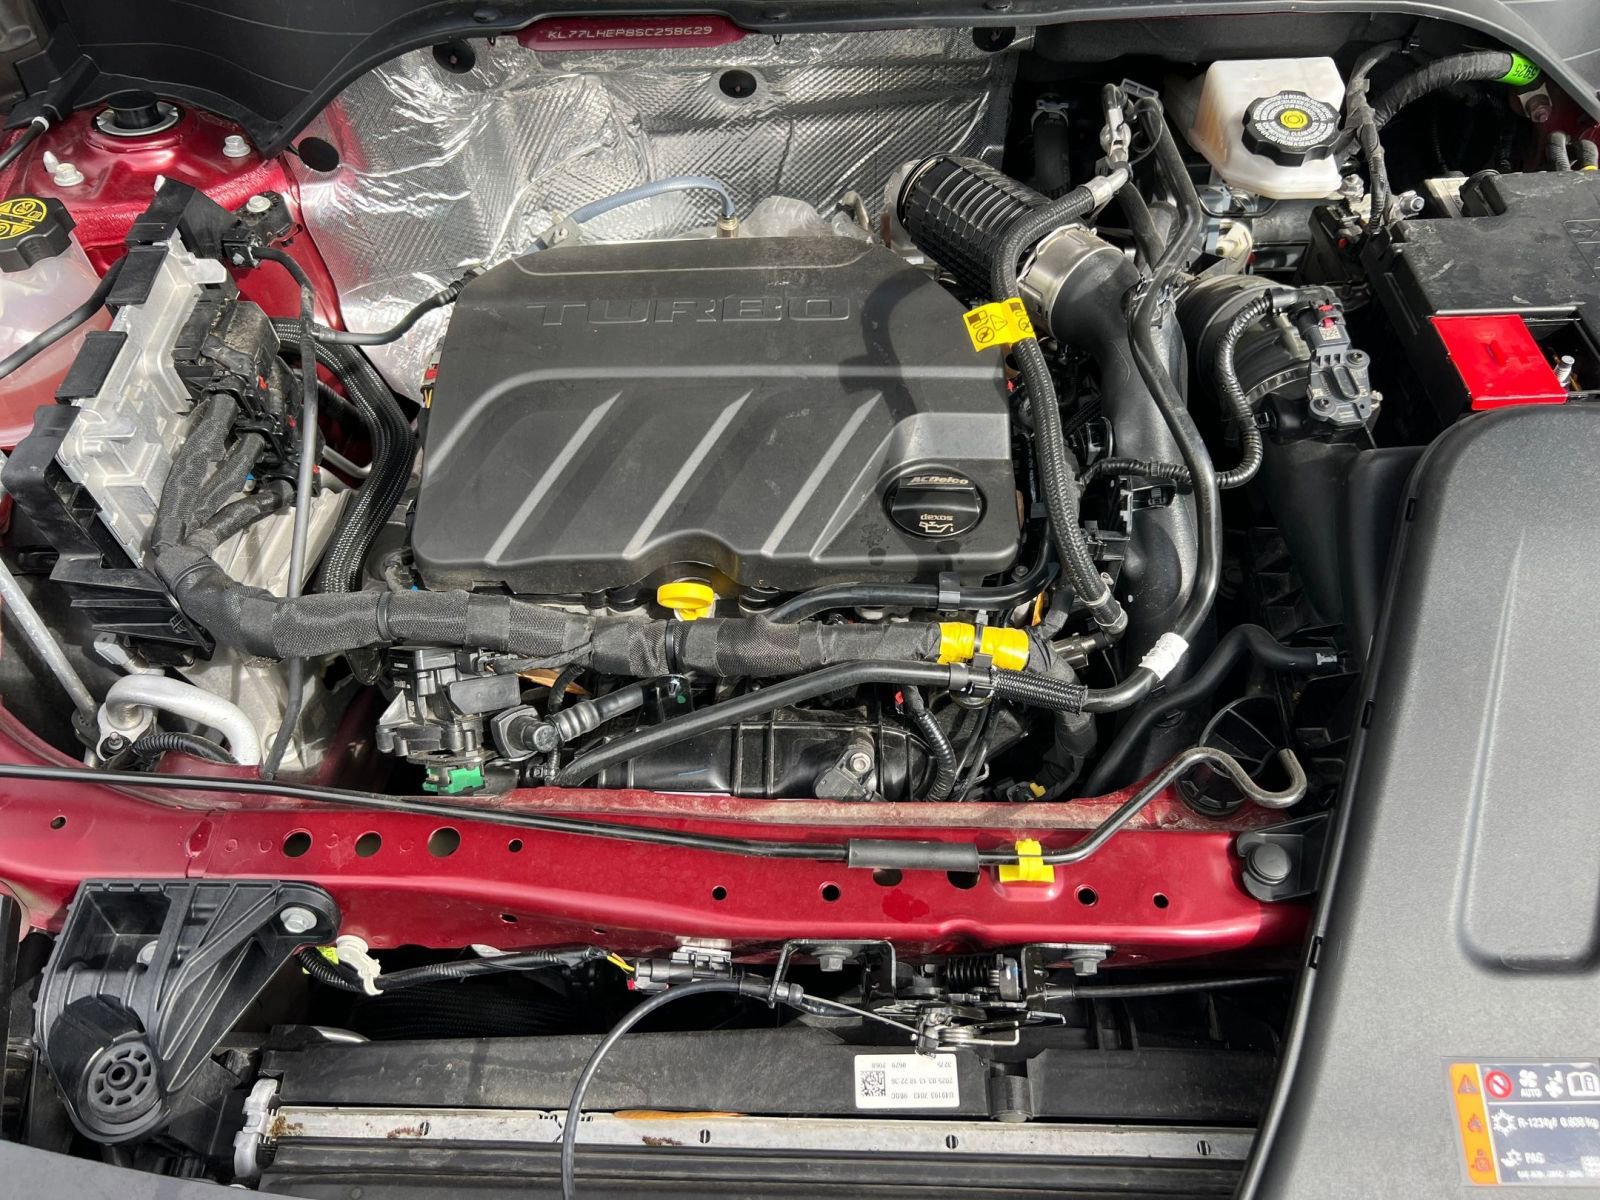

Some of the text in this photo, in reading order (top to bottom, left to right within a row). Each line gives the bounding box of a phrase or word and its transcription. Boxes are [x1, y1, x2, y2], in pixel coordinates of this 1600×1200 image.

[547, 26, 713, 40] KL77LHEP8SC258629
[526, 296, 850, 326] TURBO
[920, 513, 954, 521] dexos
[1520, 1088, 1542, 1098] AUTO
[1524, 1151, 1546, 1164] PAG
